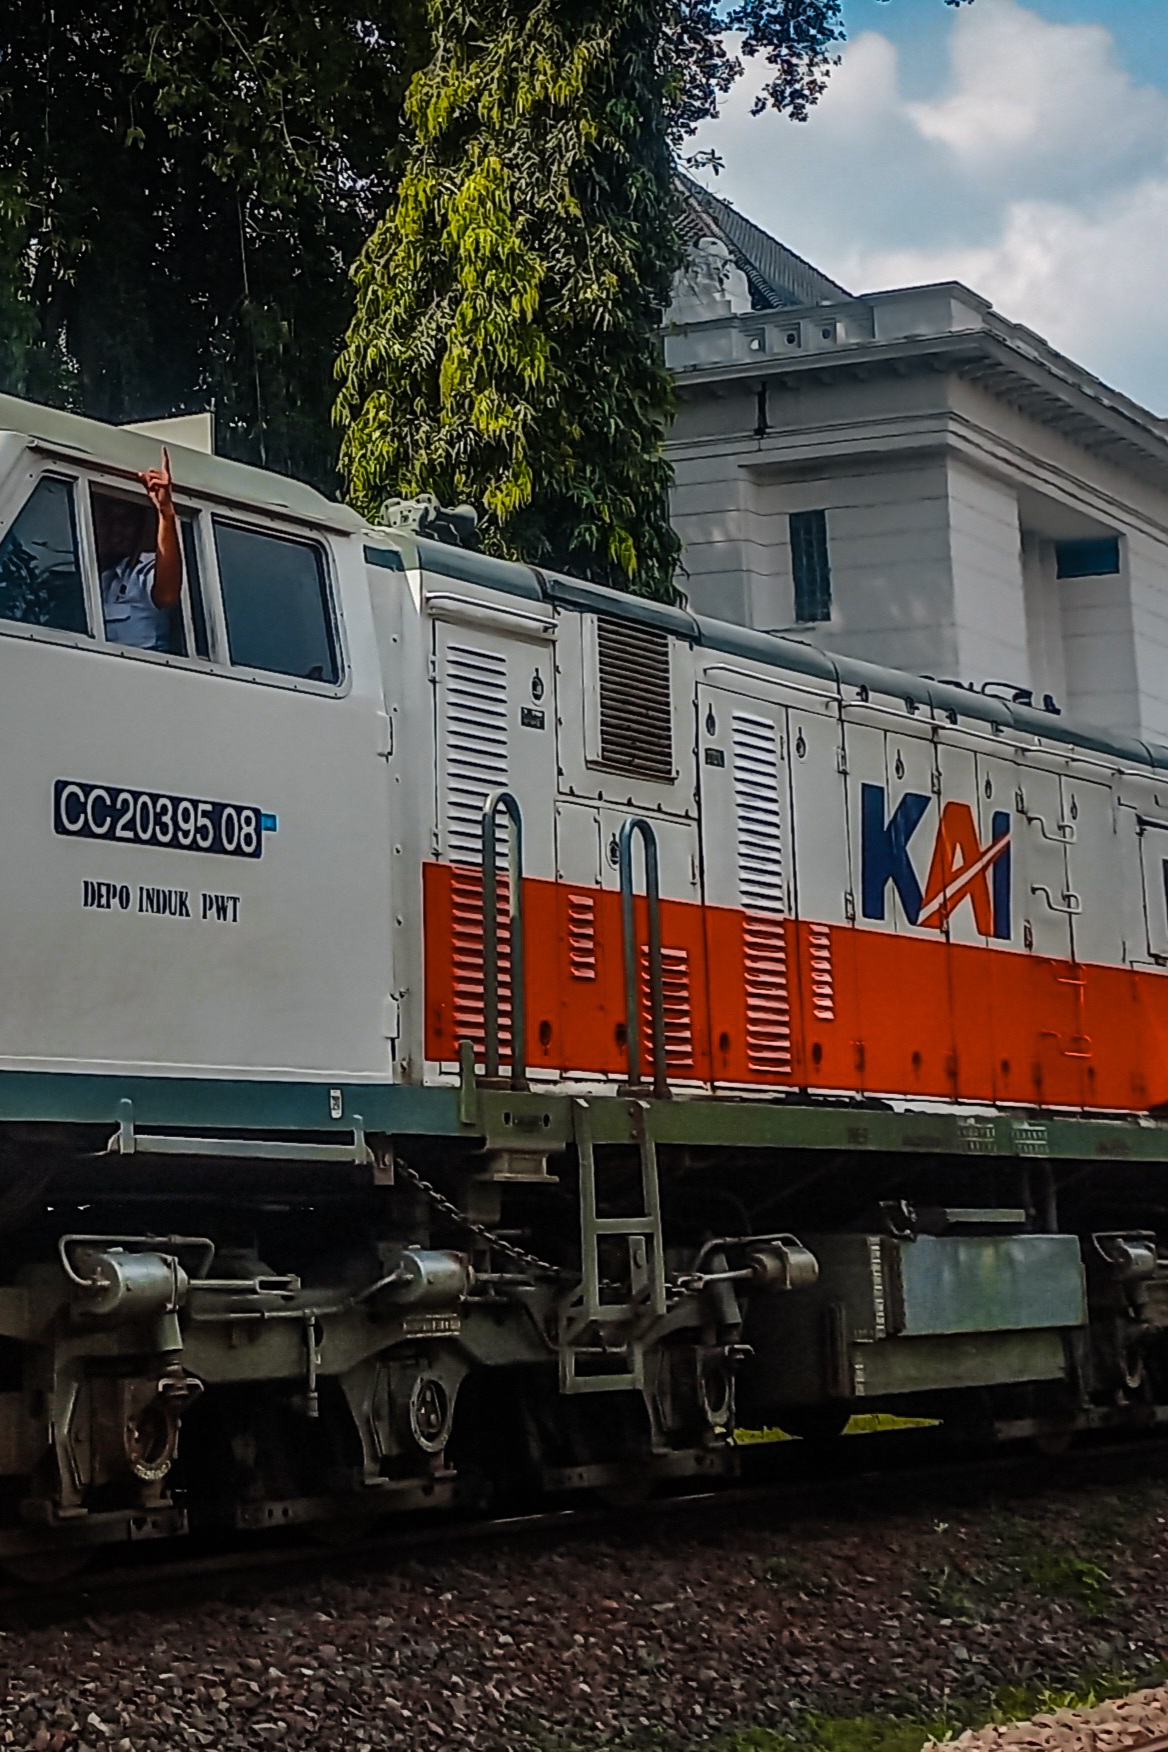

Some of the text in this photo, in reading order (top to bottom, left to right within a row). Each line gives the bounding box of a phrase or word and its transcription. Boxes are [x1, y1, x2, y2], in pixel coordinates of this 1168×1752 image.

[83, 880, 240, 922] DEPO INDUK PWT
[862, 783, 1011, 940] KAI
